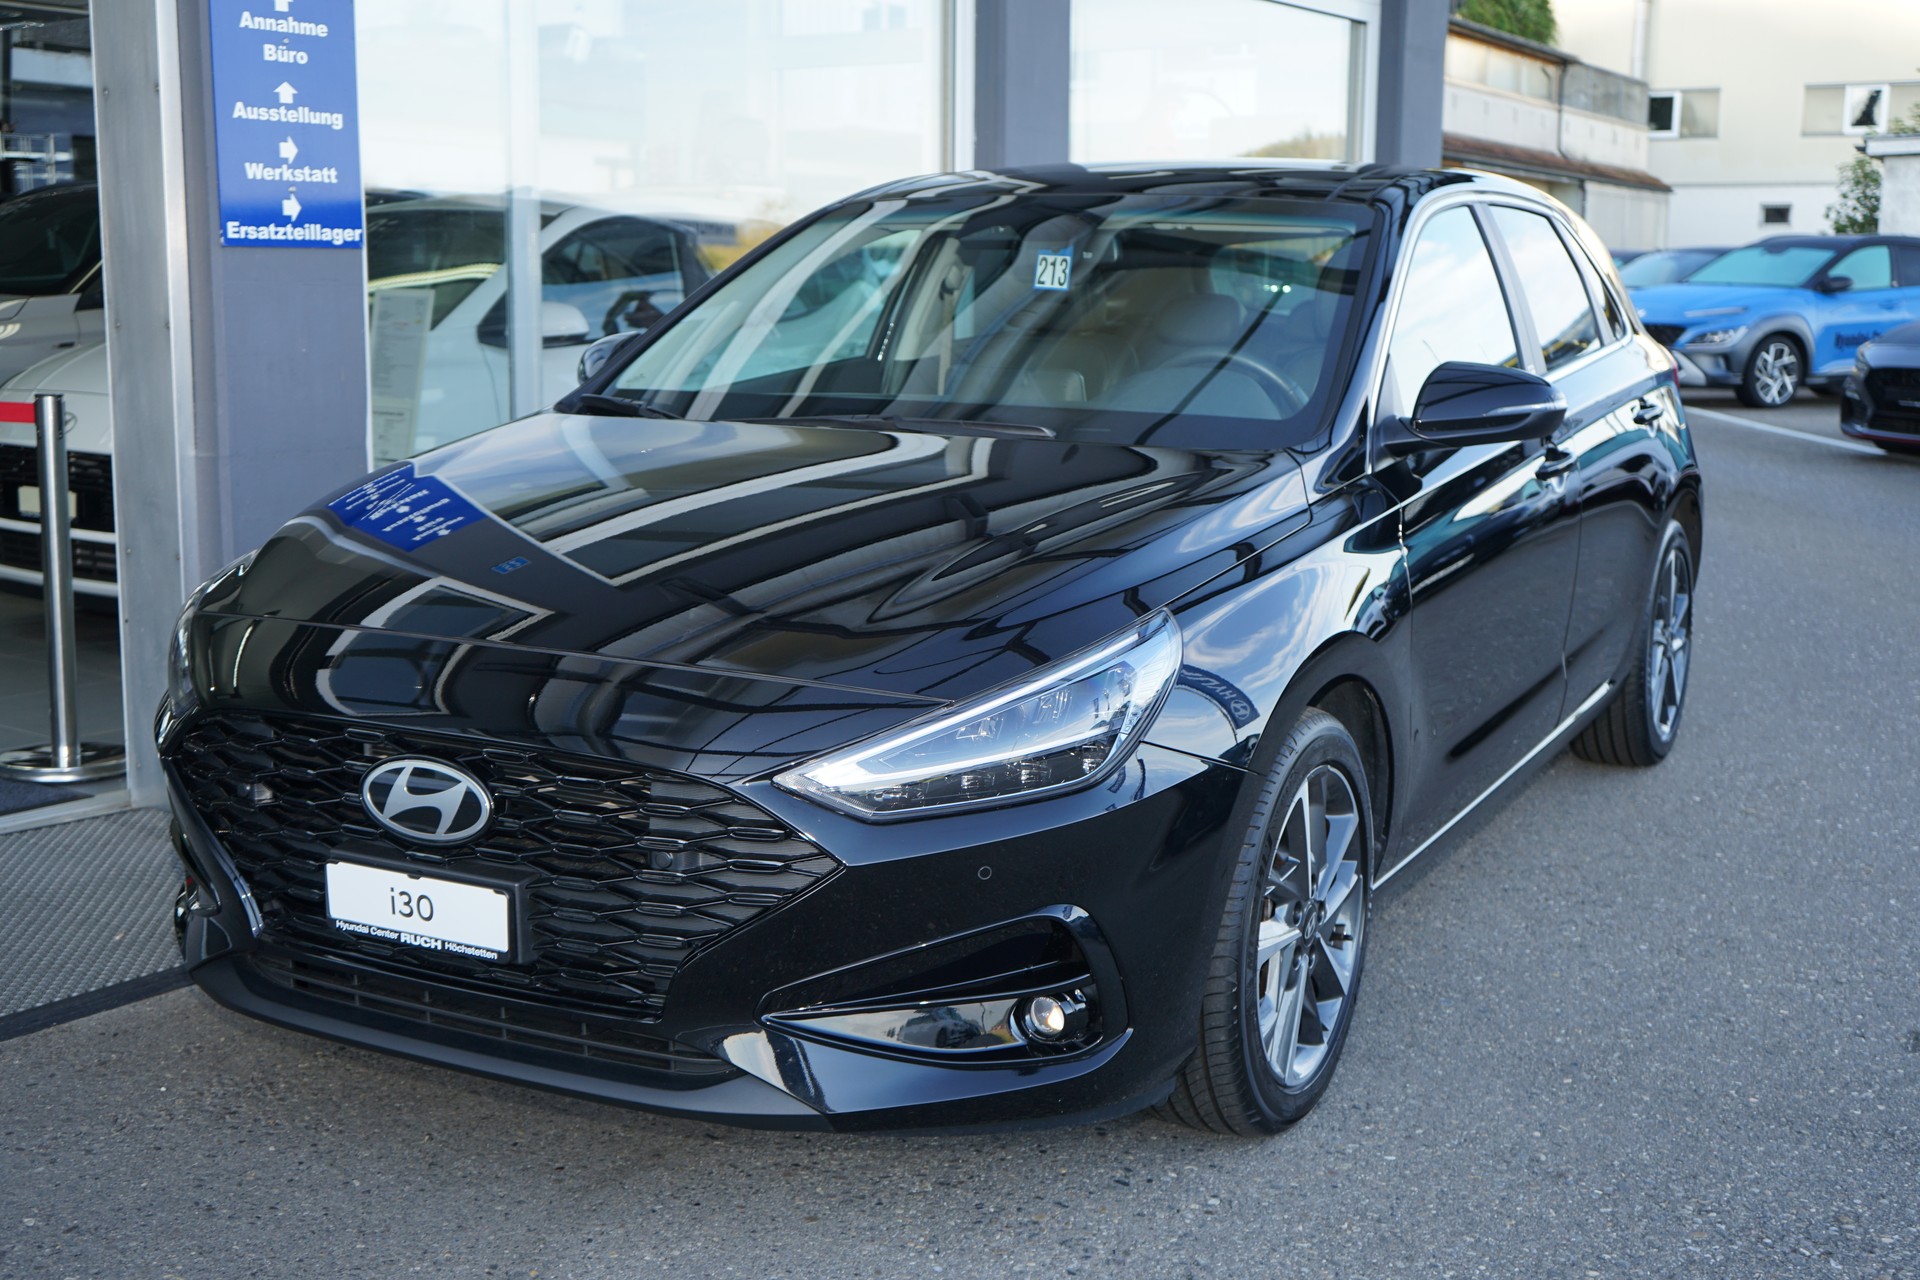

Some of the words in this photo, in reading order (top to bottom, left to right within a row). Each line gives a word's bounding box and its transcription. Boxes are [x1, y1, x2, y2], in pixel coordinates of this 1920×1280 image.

[239, 11, 329, 38] Annahme
[262, 43, 309, 65] Büro
[232, 101, 344, 130] Ausstellung
[244, 161, 339, 184] Werkstatt
[226, 221, 363, 246] Ersatzteillager
[1037, 256, 1069, 287] 213
[390, 887, 434, 922] i30
[335, 919, 370, 934] Hyundai
[370, 926, 400, 940] Center
[400, 932, 443, 950] RUCH
[444, 941, 499, 960] Höchstetten
